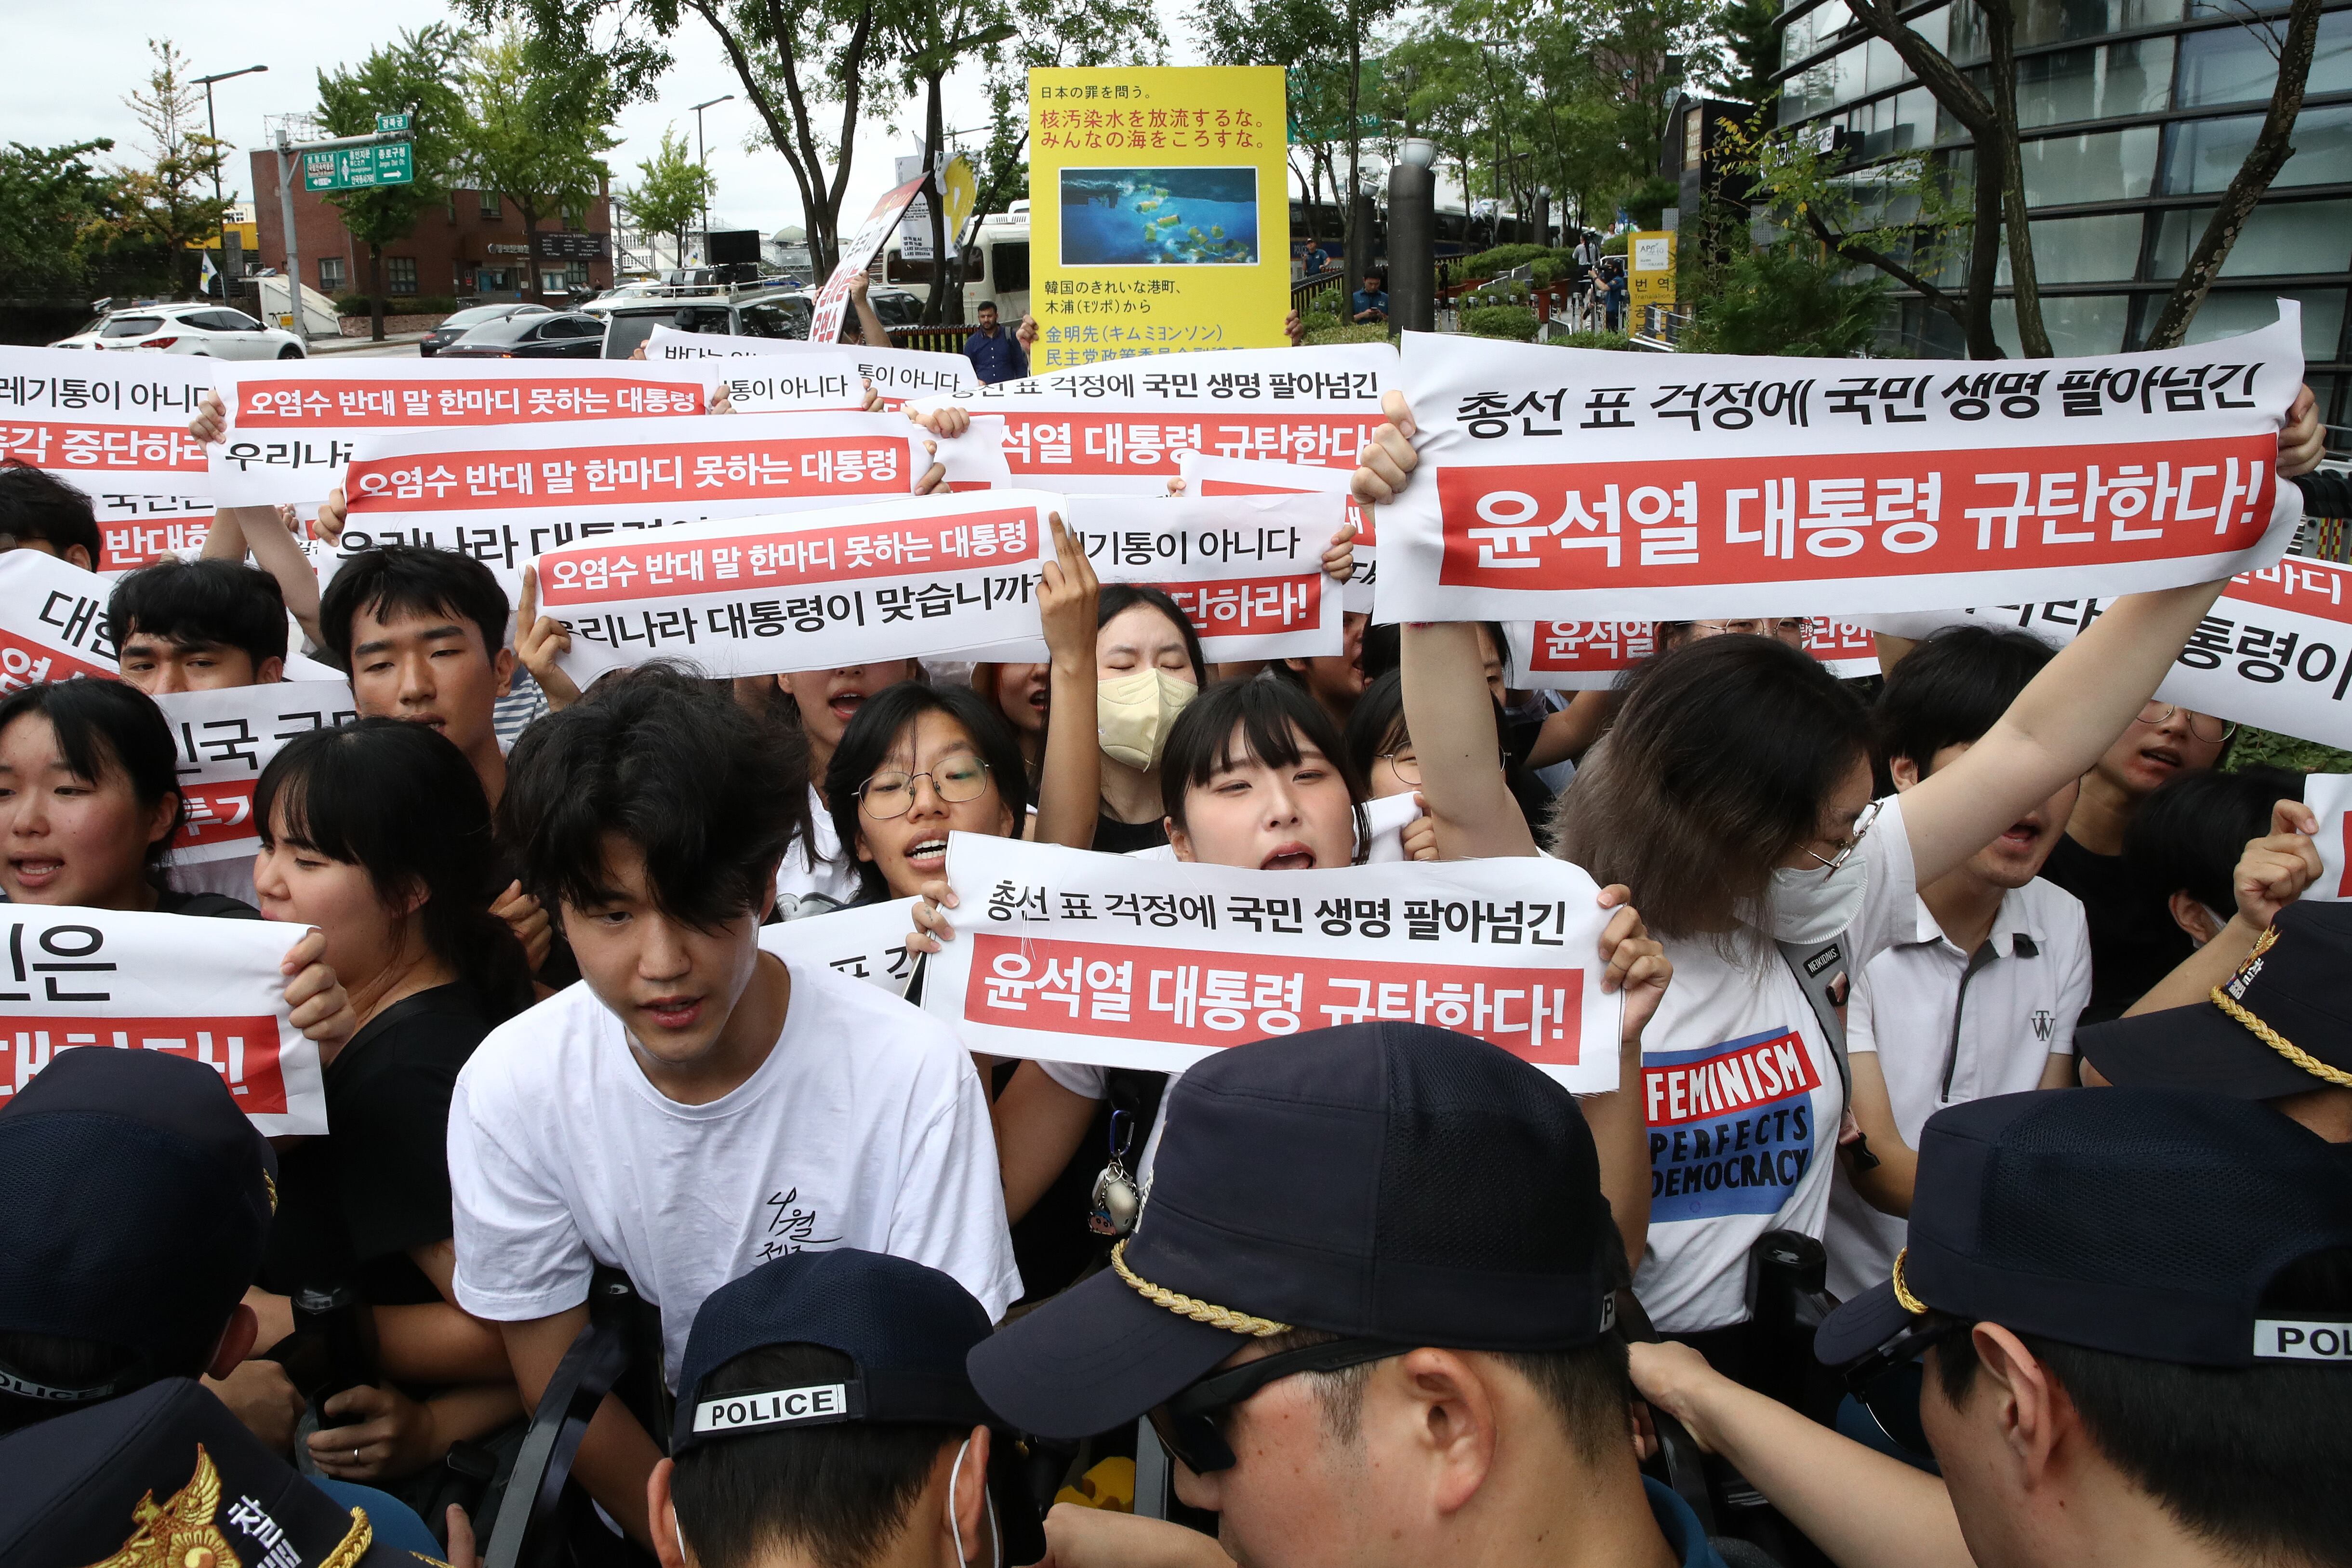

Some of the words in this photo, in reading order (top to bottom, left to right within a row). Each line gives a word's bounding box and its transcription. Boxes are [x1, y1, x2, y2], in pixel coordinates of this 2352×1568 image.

[1041, 85, 1151, 100] 日本の罪を問う。
[1040, 108, 1263, 129] 核汚染水を放流するな。
[378, 147, 406, 160] 종로구청
[1040, 129, 1263, 149] みんなの海をころすな。
[1044, 279, 1182, 296] 韓国のきれいな港町、
[724, 378, 773, 401] 통이
[781, 374, 848, 399] 아니다
[900, 369, 960, 392] 아니다
[1050, 375, 1134, 399] 걱정에
[1143, 373, 1198, 399] 국민
[1207, 372, 1260, 399] 생명
[1269, 372, 1378, 399] 팔아넘긴
[1457, 388, 1568, 439] 총선
[1580, 387, 1636, 429] 표
[1650, 379, 1816, 431] 걱정에
[1824, 374, 1933, 425] 국민
[1941, 370, 2051, 421] 생명
[2057, 362, 2265, 417] 팔아넘긴
[247, 391, 331, 418] 오염수
[338, 389, 395, 417] 반대
[402, 390, 432, 416] 말
[439, 388, 520, 416] 한마디
[528, 387, 610, 414] 못하는
[617, 387, 695, 413] 대통령
[1085, 424, 1202, 466] 대통령
[359, 465, 456, 499] 오염수
[465, 462, 533, 496] 반대
[542, 460, 577, 494] 말
[584, 455, 683, 492] 한마디
[693, 452, 793, 489] 못하는
[801, 447, 898, 483] 대통령
[1467, 481, 1700, 569] 윤석열
[1725, 472, 1941, 559] 대통령
[1965, 456, 2265, 551] 규탄한다!
[552, 555, 639, 591] 오염수
[645, 548, 704, 584] 반대
[711, 545, 742, 578] 말
[748, 537, 836, 576] 한마디
[844, 532, 933, 569] 못하는
[940, 518, 1028, 560] 대통령
[1076, 531, 1187, 566] 기통이
[1199, 527, 1301, 560] 아니다
[2231, 563, 2342, 604] 마디
[706, 590, 865, 639] 대통령이
[988, 879, 1050, 922] 총선
[1060, 892, 1098, 920] 표
[1105, 892, 1217, 930] 걱정에
[1227, 895, 1303, 934] 국민
[1314, 897, 1391, 938] 생명
[1403, 898, 1566, 947] 팔아넘긴
[984, 953, 1133, 1023] 윤석열
[1149, 964, 1304, 1035] 대통령
[1646, 1040, 1807, 1121] FEMINISM
[1650, 1105, 1808, 1165] PERFECTS
[712, 1389, 836, 1427] POLICE
